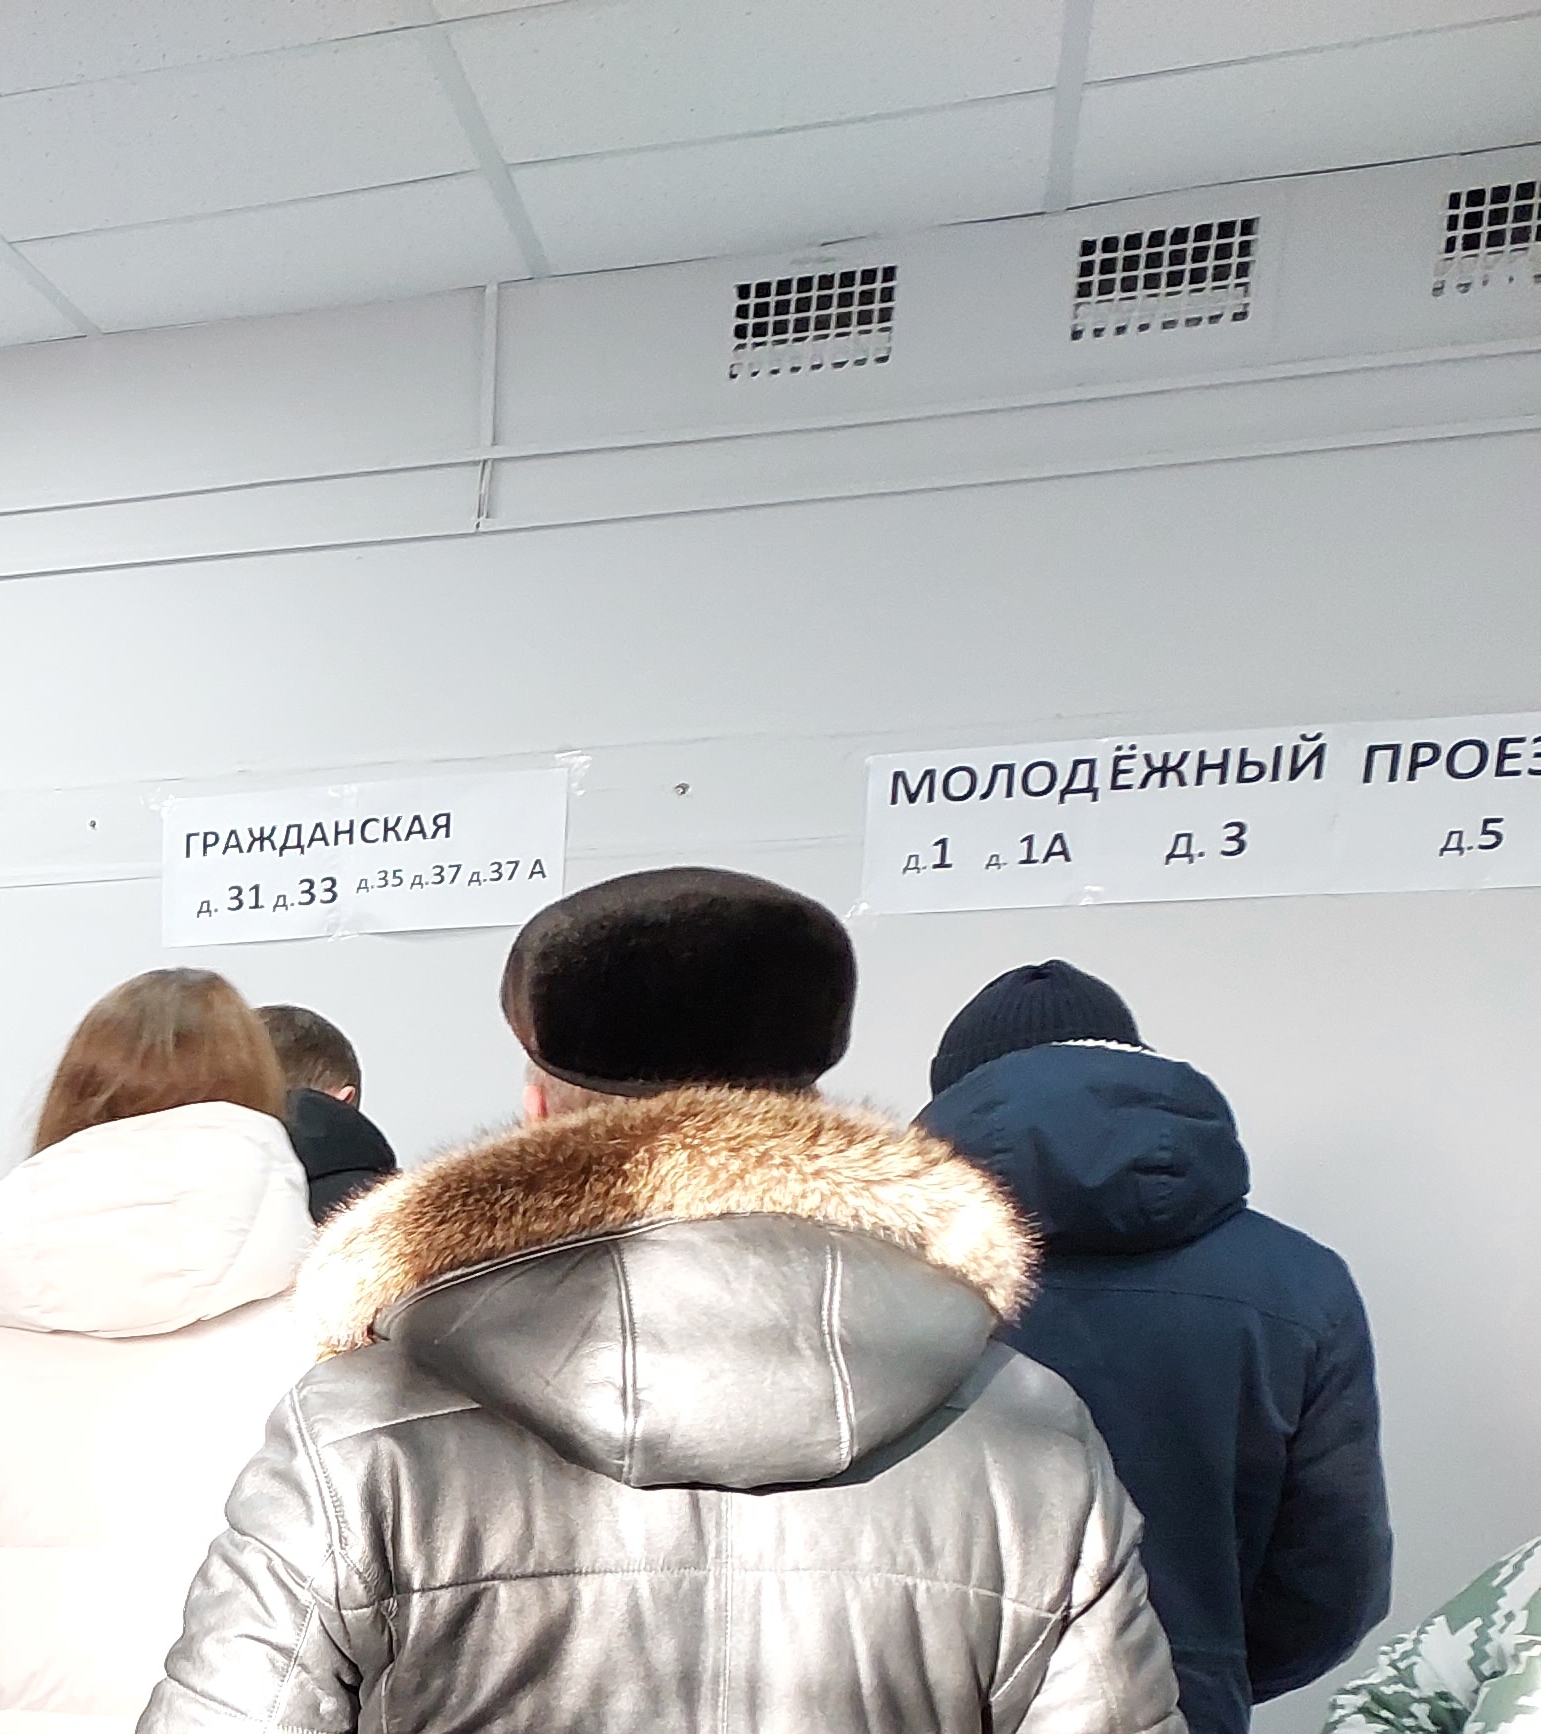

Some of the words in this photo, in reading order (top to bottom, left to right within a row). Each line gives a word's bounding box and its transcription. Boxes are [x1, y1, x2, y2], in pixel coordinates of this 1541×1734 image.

[889, 731, 1327, 806] МОЛОДЁЖНЫЙ
[185, 811, 452, 858] ГРАЖДАНСКАЯ
[1220, 821, 1249, 857] 3
[1438, 817, 1505, 857] д.5
[196, 899, 218, 918] д.
[227, 883, 264, 912] 31
[272, 876, 339, 912] д.33
[356, 868, 404, 894] д.35
[410, 863, 462, 890] д.37
[467, 859, 520, 887] д.37
